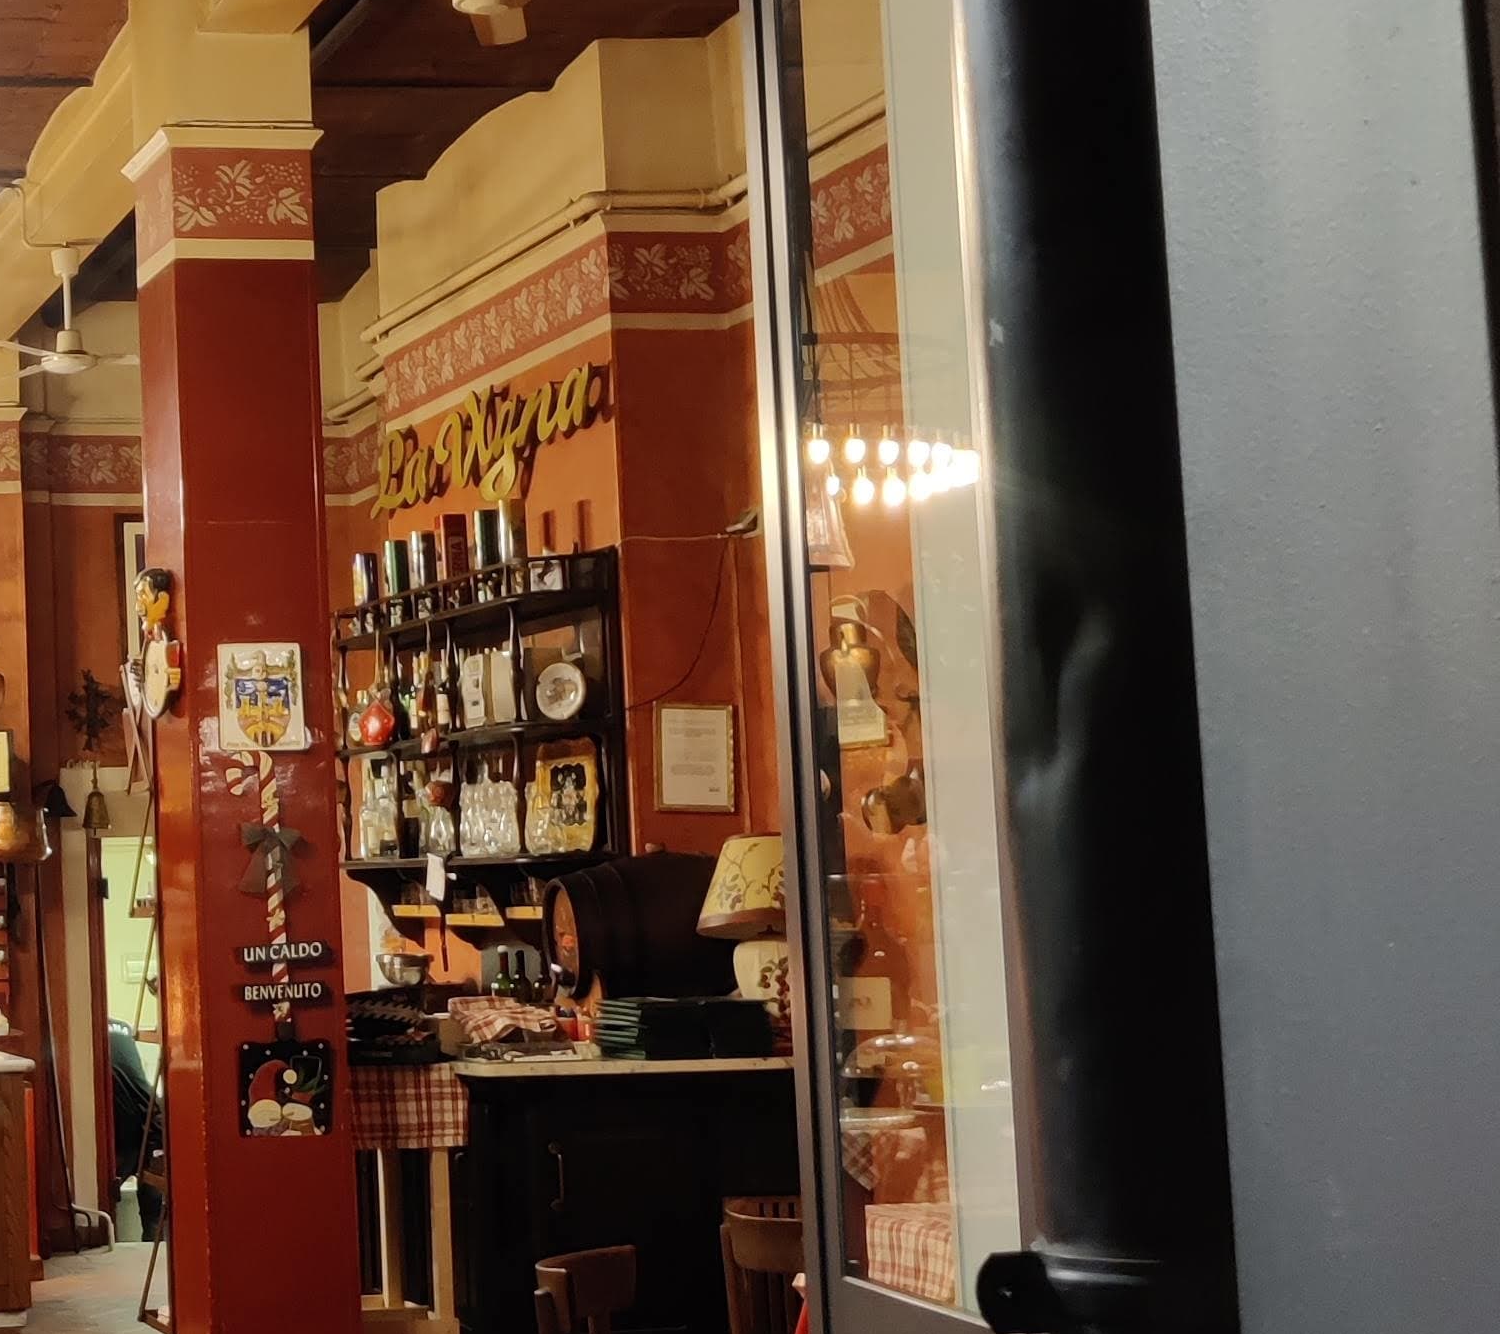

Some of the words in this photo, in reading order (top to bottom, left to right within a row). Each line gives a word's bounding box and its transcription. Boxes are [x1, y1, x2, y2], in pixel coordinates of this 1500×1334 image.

[370, 429, 429, 519] La
[434, 362, 591, 502] Vigna
[243, 946, 266, 962] UN
[269, 941, 323, 960] CALDO
[244, 982, 322, 1001] BENVENUTO
